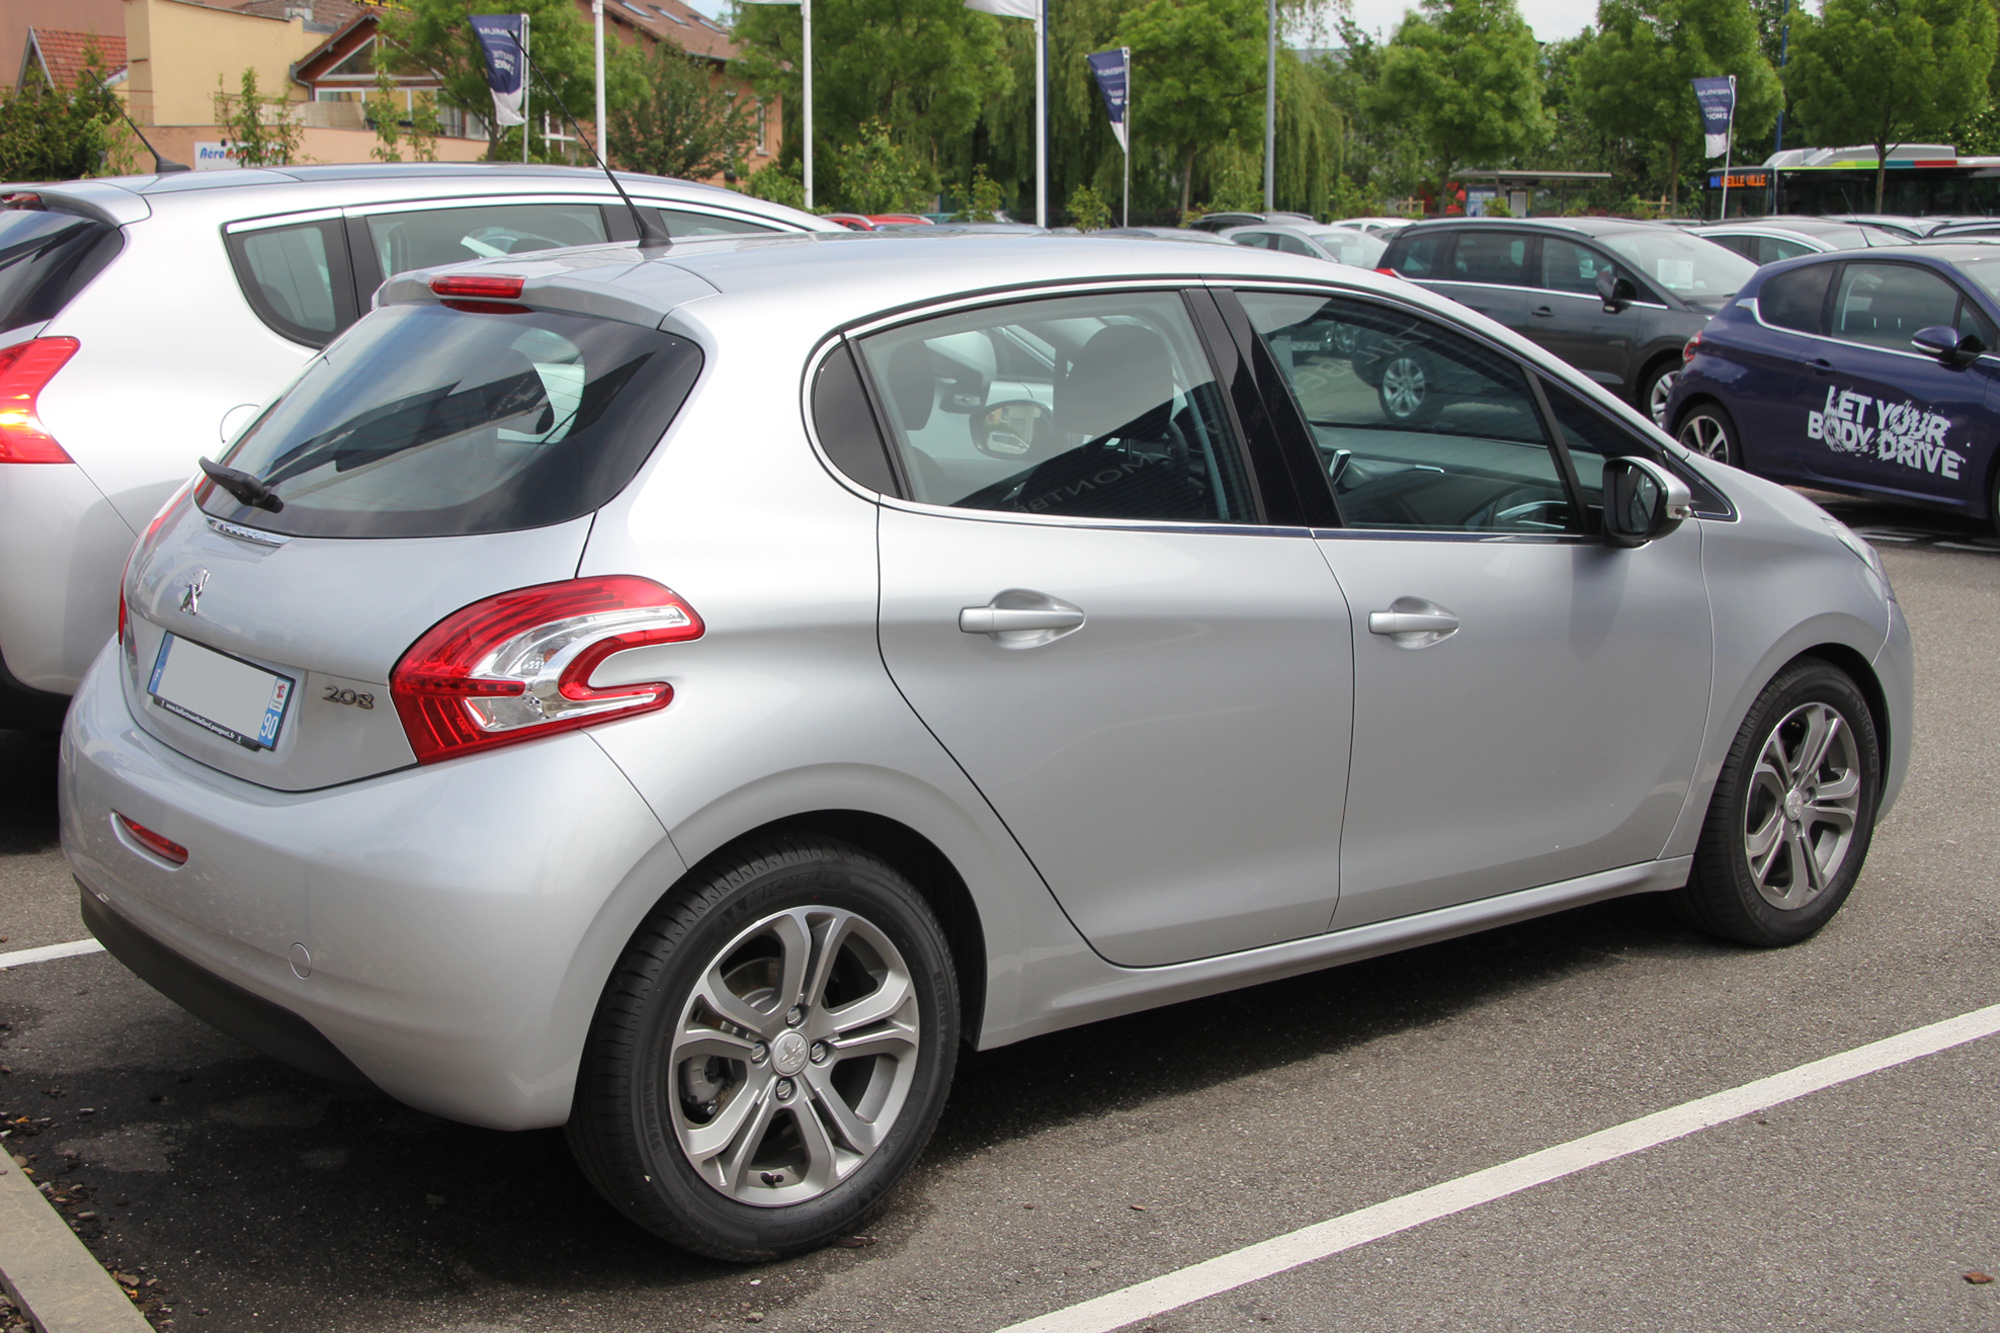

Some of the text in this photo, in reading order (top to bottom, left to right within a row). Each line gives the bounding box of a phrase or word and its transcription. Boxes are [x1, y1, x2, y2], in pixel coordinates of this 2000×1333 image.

[1720, 175, 1745, 187] VEILLE
[1824, 385, 1951, 447] LET YOUR
[1807, 410, 1965, 480] BODY DRIVE
[322, 684, 374, 710] 208
[260, 711, 280, 740] 90
